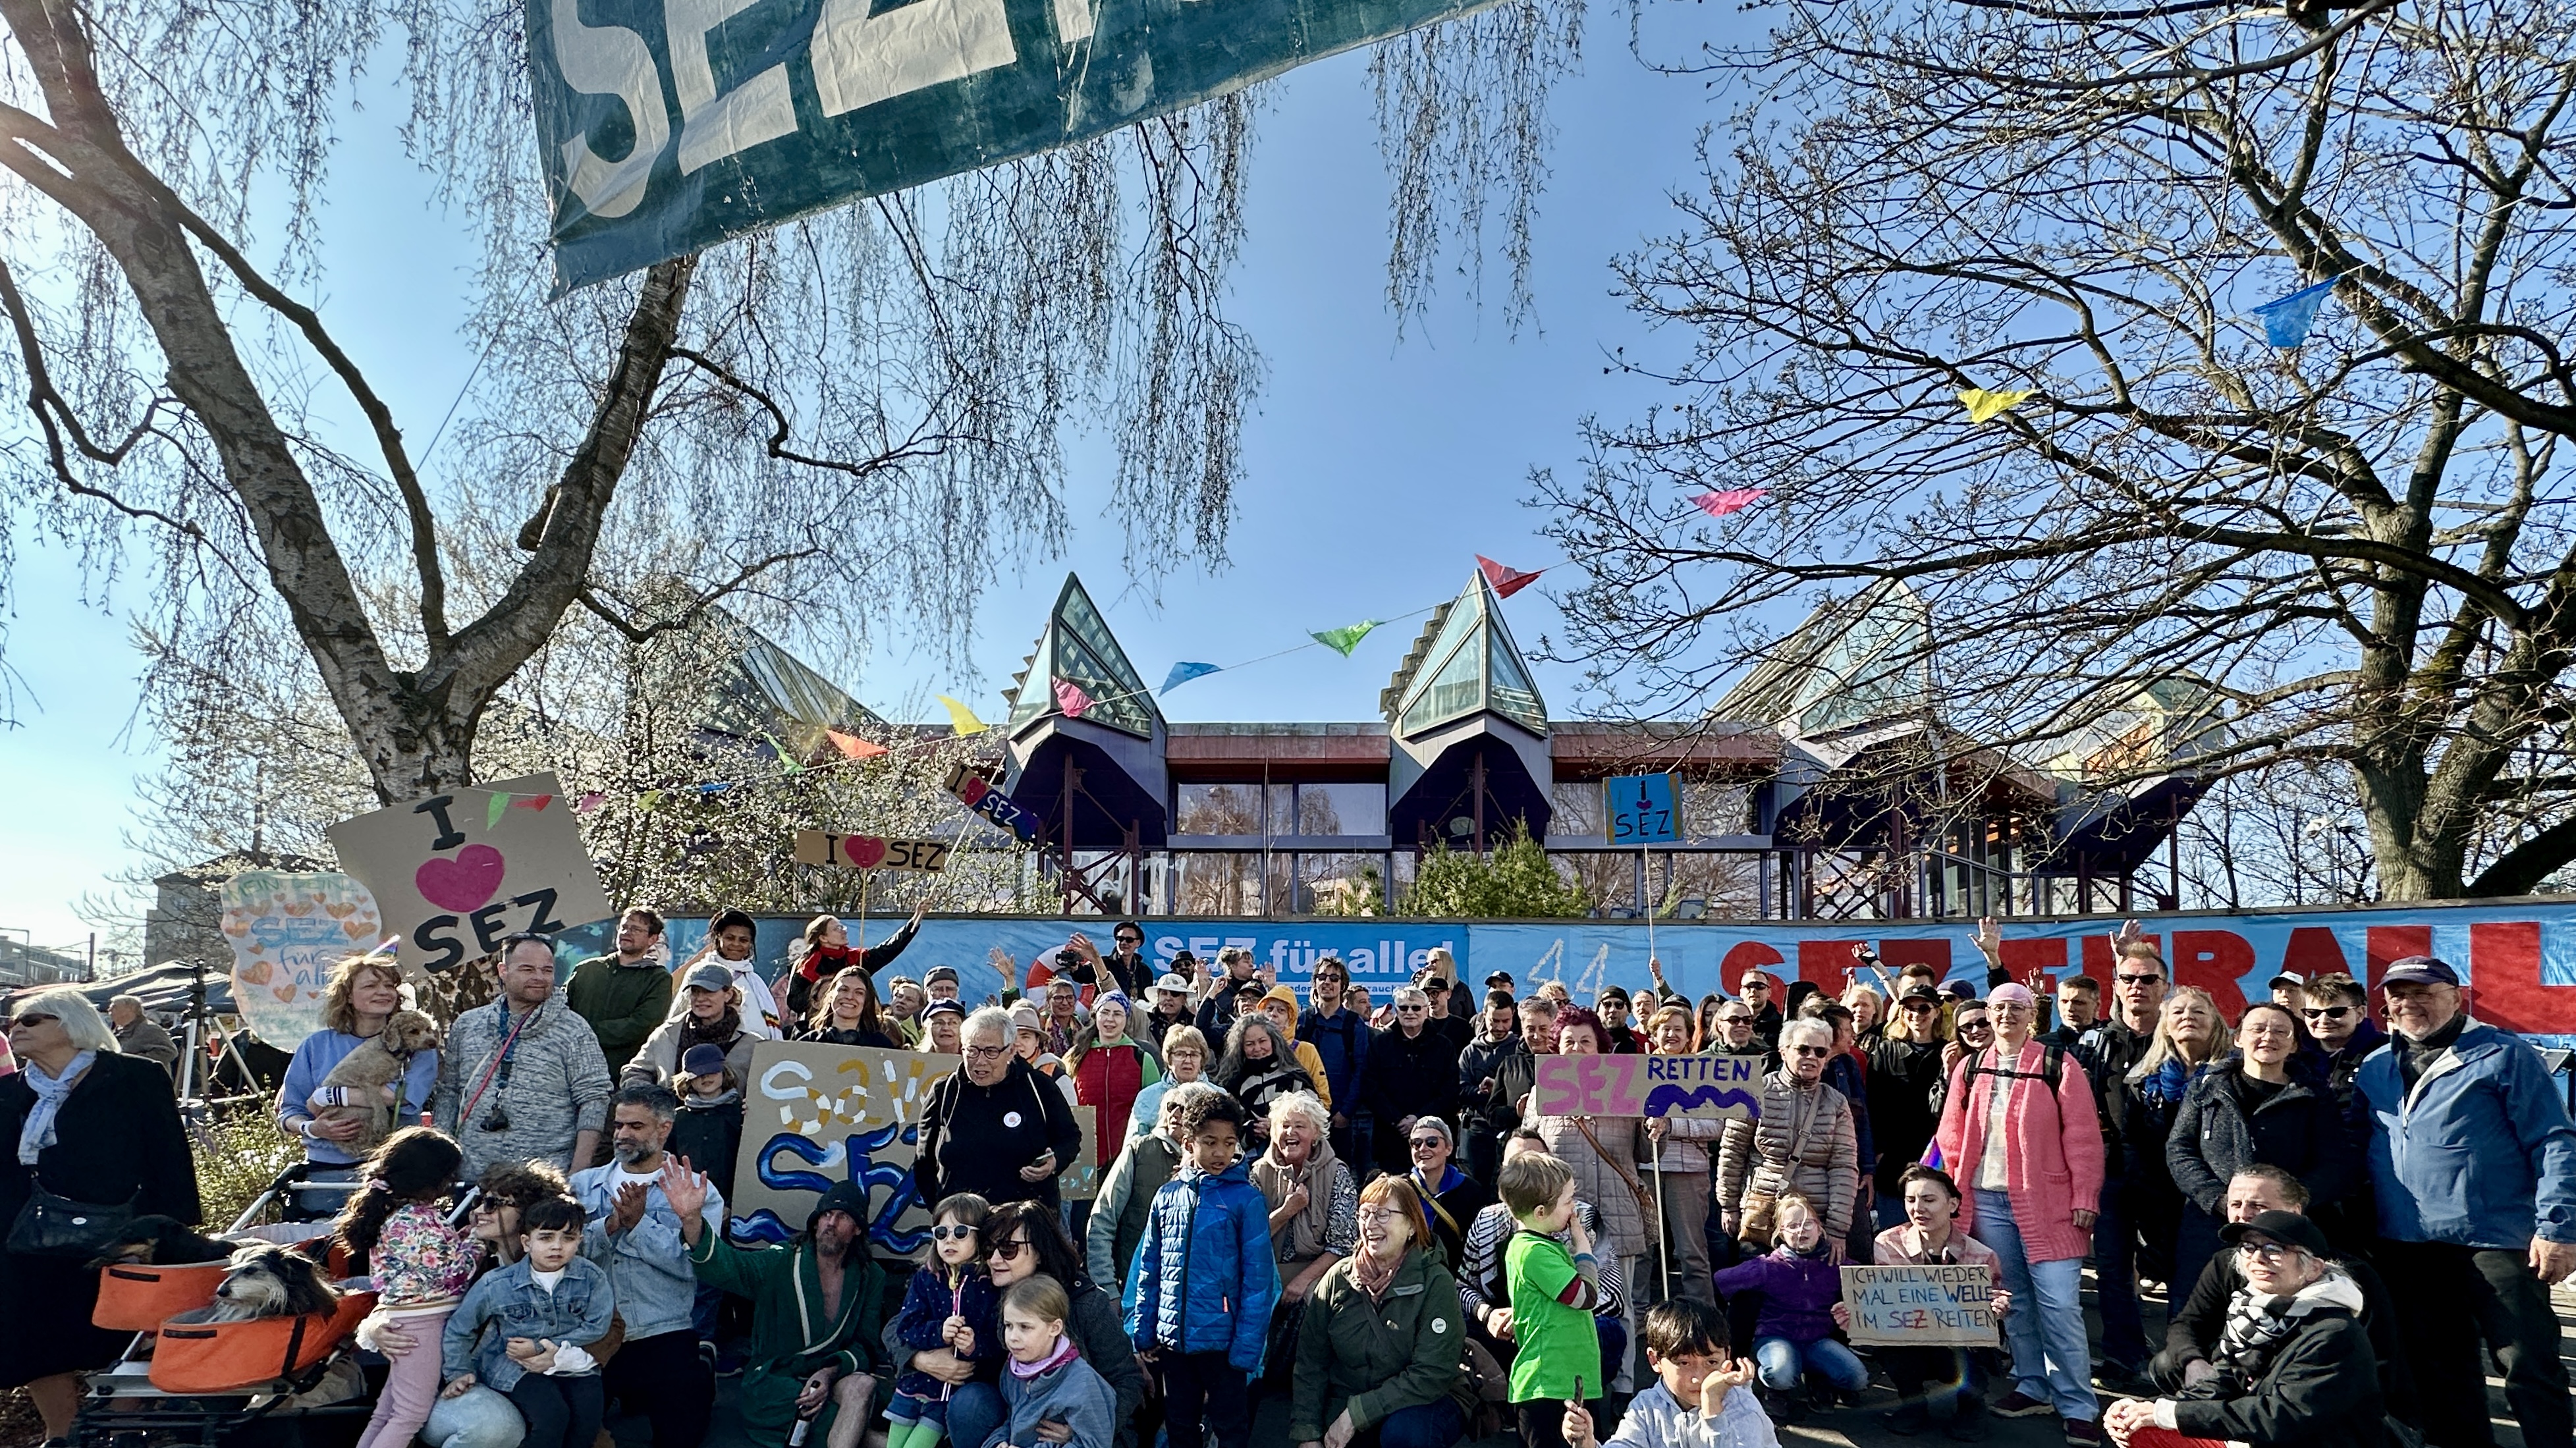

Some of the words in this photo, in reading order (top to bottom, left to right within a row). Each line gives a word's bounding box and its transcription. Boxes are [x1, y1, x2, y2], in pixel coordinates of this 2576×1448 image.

[949, 764, 968, 793] I
[983, 794, 1021, 826] SEZ
[1640, 780, 1647, 801] I
[413, 795, 466, 851] I
[1614, 810, 1670, 838] SEZ
[825, 834, 838, 865] I
[887, 842, 945, 871] SEZ
[251, 917, 348, 948] SEZ
[414, 888, 566, 974] SEZ
[280, 946, 329, 975] für
[296, 963, 334, 986] all
[761, 1059, 950, 1135] Sav
[1538, 1054, 1640, 1115] SEZ
[1648, 1057, 1751, 1081] RETTEN
[1851, 1268, 1877, 1284] ICH
[1882, 1269, 1919, 1283] WILL
[1923, 1267, 1988, 1283] WIEDER
[1853, 1289, 1894, 1305] MAL
[1899, 1287, 1939, 1302] EINE
[1855, 1311, 1878, 1328] IM
[1888, 1309, 1928, 1329] SEZ
